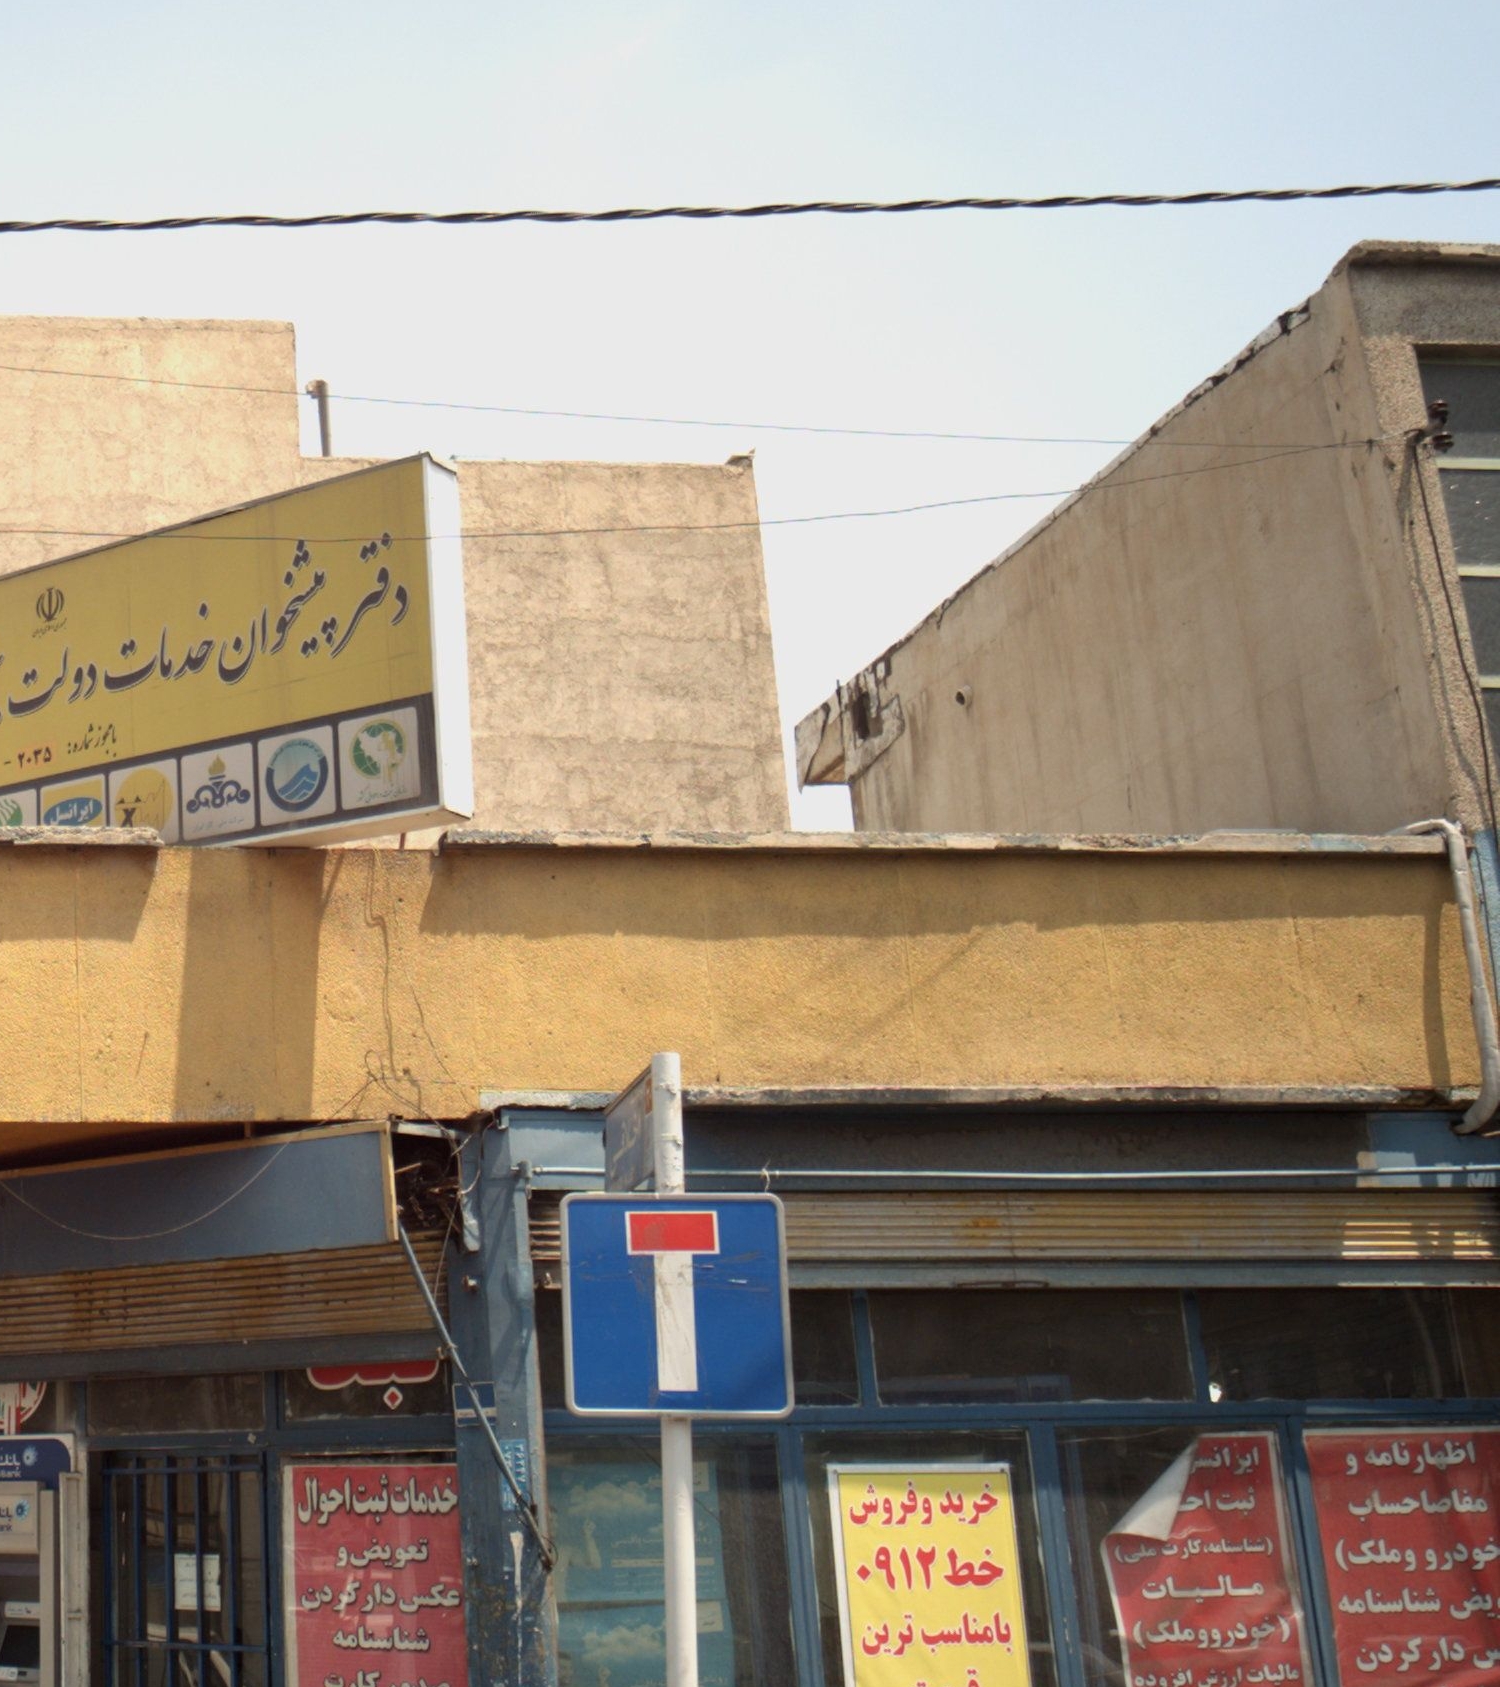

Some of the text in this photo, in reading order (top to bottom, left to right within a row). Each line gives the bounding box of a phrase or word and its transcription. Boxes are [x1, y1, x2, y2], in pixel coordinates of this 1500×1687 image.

[218, 539, 338, 685] پیشخوان
[330, 532, 409, 659] دفتر
[104, 602, 215, 691] خدمات
[8, 646, 98, 717] دولت
[50, 799, 94, 826] ایرانسل
[1346, 1452, 1359, 1476] و
[297, 1475, 351, 1525] احوال
[352, 1474, 389, 1523] ثبت
[389, 1475, 458, 1514] خدمات
[939, 1483, 999, 1525] خرید
[1216, 1486, 1256, 1515] ثبت
[335, 1537, 429, 1568] تعویض و
[856, 1546, 1004, 1590] خط ۰۹۱۲
[399, 1583, 461, 1613] عکس
[1142, 1575, 1265, 1603] مالیات
[1338, 1587, 1441, 1614] شناسنامه
[333, 1626, 431, 1651] شناسنامه
[862, 1614, 914, 1656] ترین
[1198, 1666, 1242, 1687] ارزش
[1246, 1663, 1300, 1685] مالیات
